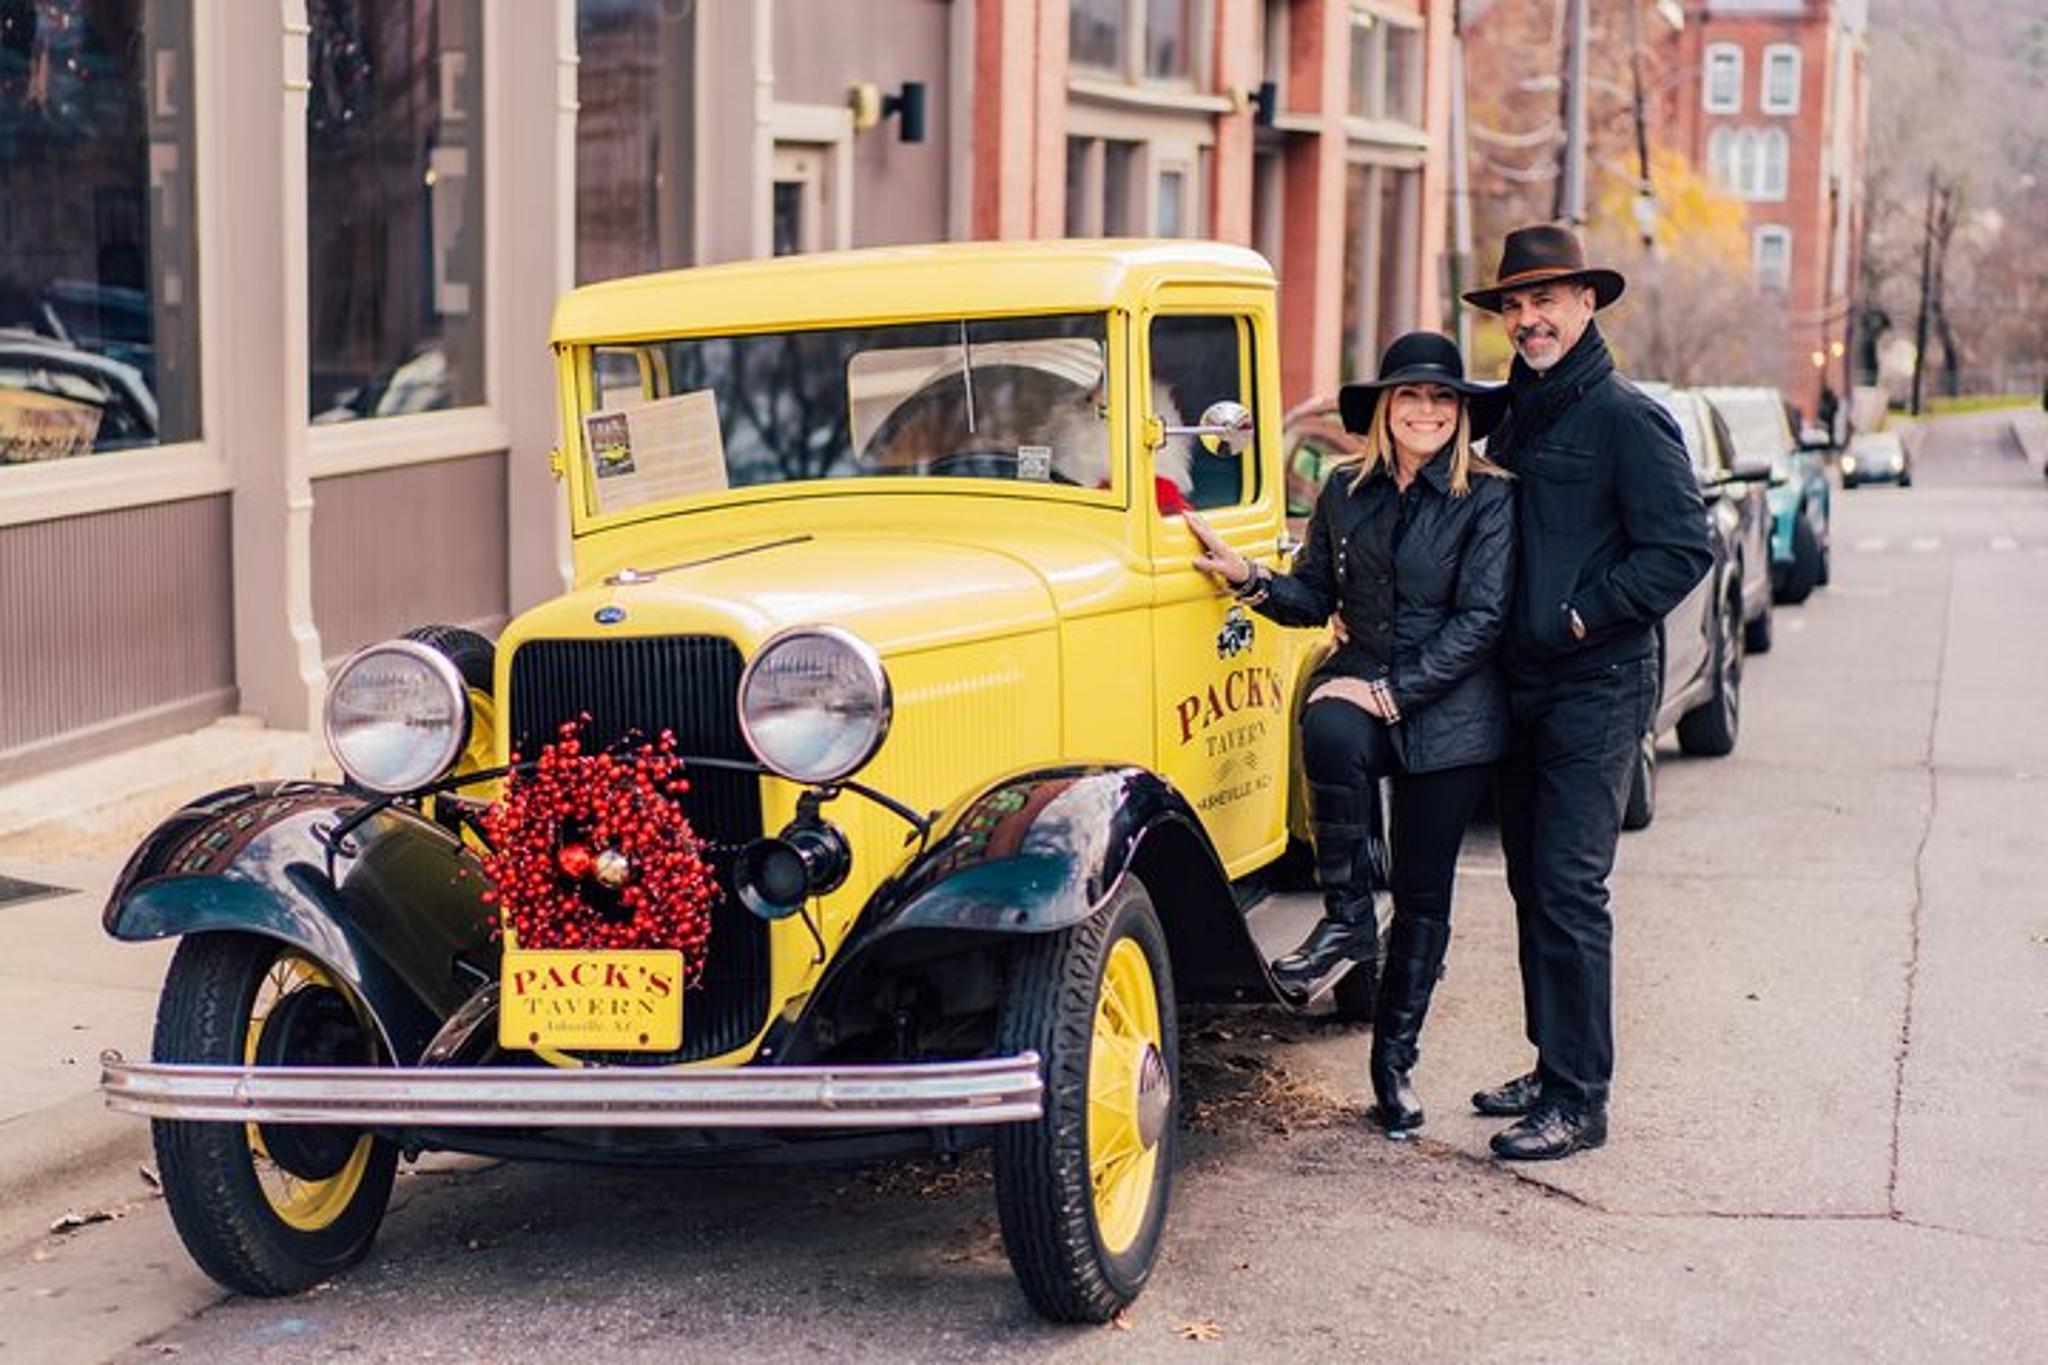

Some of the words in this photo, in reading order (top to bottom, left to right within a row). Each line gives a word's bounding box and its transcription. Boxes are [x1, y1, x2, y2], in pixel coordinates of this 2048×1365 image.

[1176, 667, 1283, 746] PACK'S
[1205, 720, 1266, 758] TAVERN
[513, 960, 672, 999] PACK'S
[524, 999, 655, 1015] TAVERN
